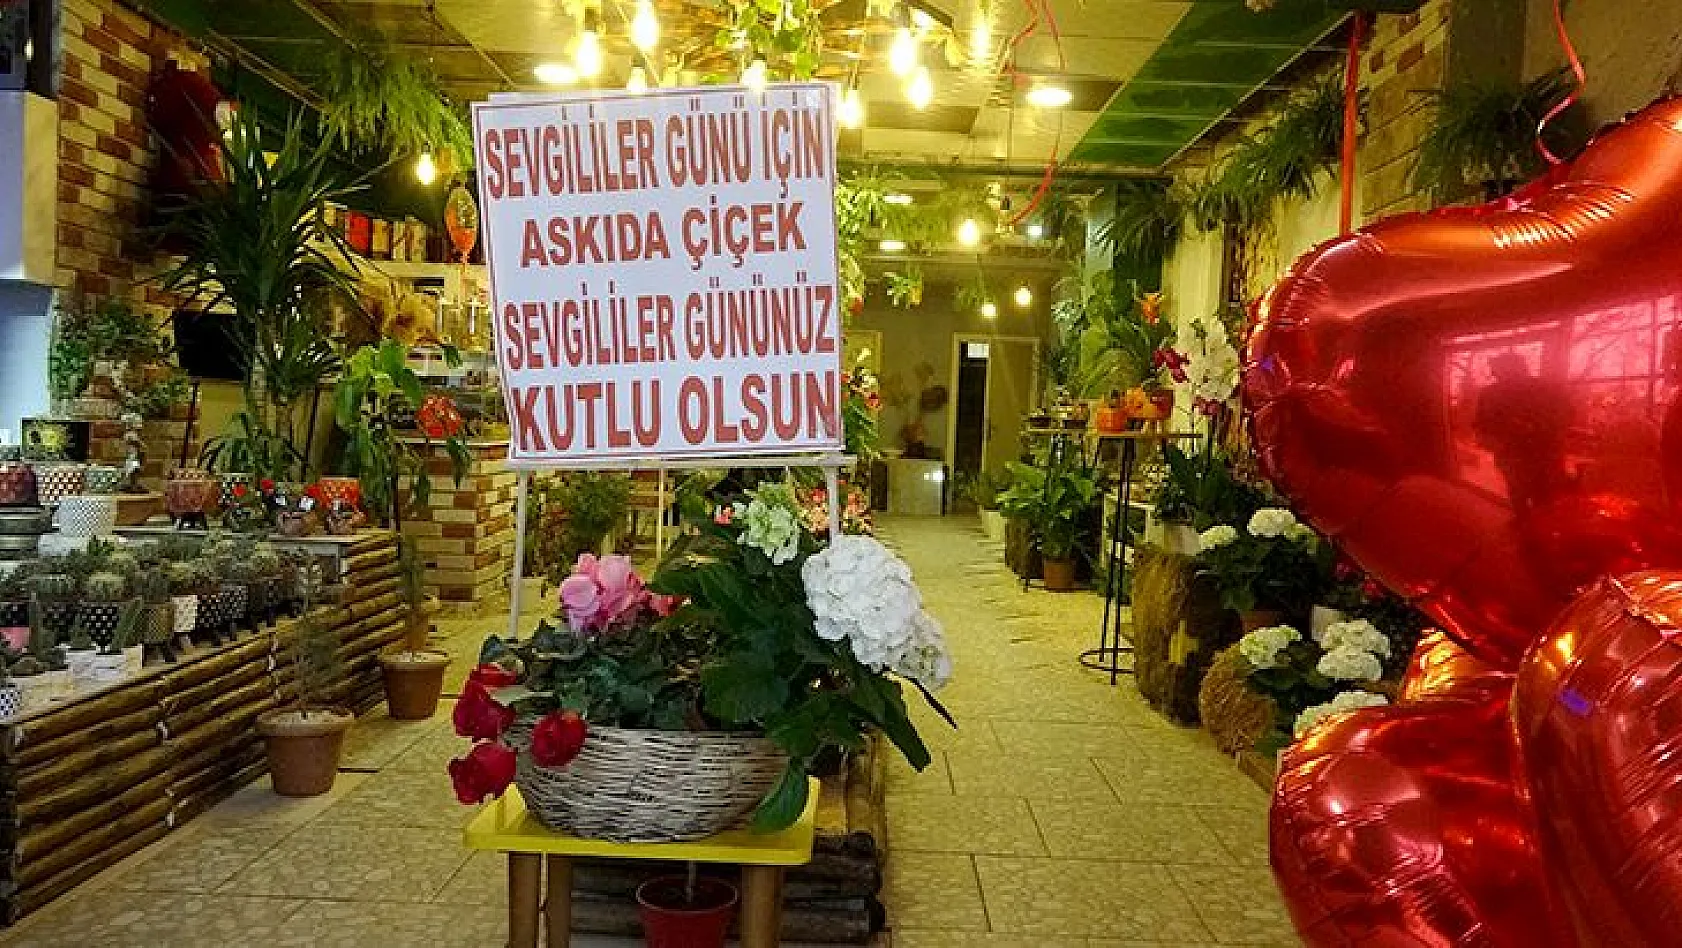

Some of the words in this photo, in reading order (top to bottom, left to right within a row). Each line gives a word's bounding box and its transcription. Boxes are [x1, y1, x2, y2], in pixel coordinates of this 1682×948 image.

[485, 104, 659, 199] SEVGİLİLER
[665, 96, 750, 188] GÜNÜ
[520, 211, 671, 268] ASKIDA
[681, 194, 807, 271] ÇİÇEK
[504, 279, 677, 371] SEVGİLİLER
[684, 270, 835, 361] GÜNÜNÜZ
[511, 378, 662, 452] KUTLU
[677, 370, 837, 446] OLSUN
